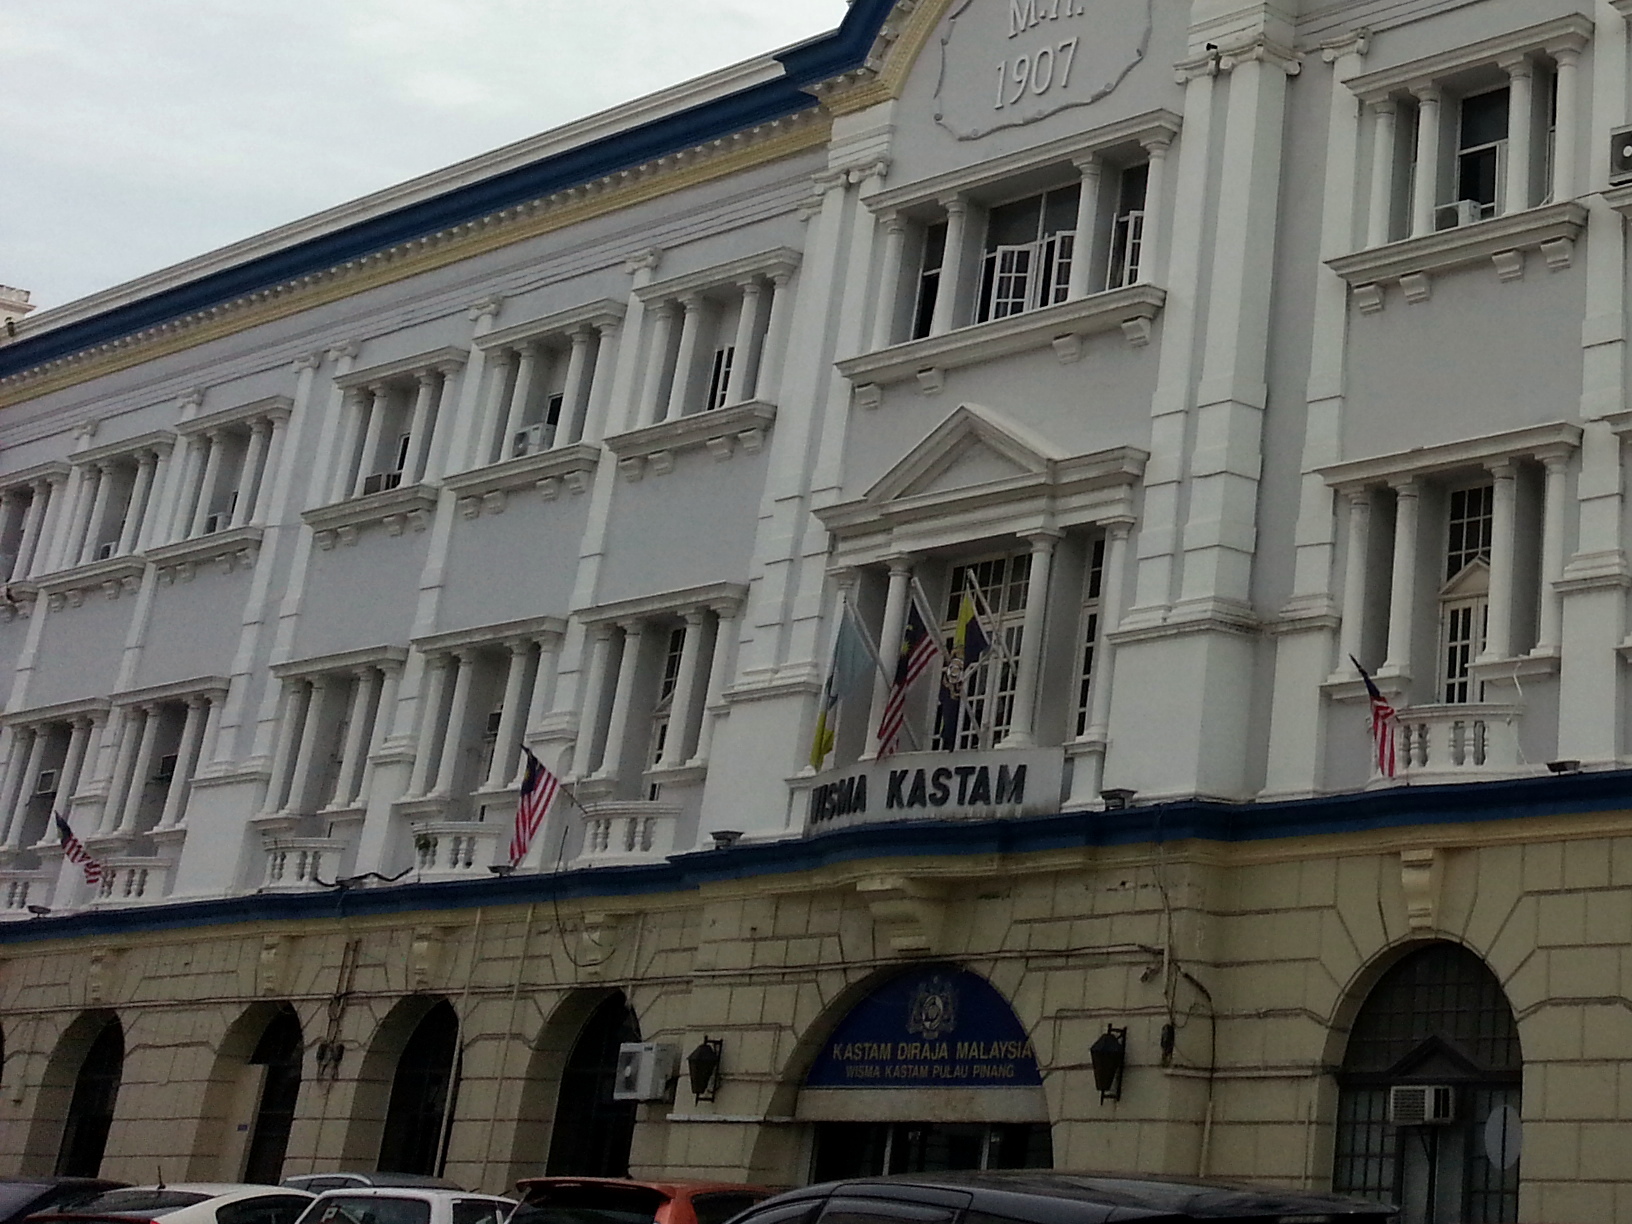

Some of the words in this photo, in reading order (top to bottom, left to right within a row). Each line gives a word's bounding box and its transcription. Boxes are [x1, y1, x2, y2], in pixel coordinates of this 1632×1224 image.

[994, 37, 1079, 110] 1907
[886, 764, 1028, 810] KASTAM
[832, 1042, 892, 1060] KASTAM
[897, 1042, 948, 1060] DIRAJA
[955, 1040, 1033, 1060] MALAYSIA
[845, 1064, 881, 1078] WISMA
[884, 1064, 929, 1078] KASTAM
[932, 1064, 968, 1078] PULAU
[973, 1063, 1015, 1078] PINANG
